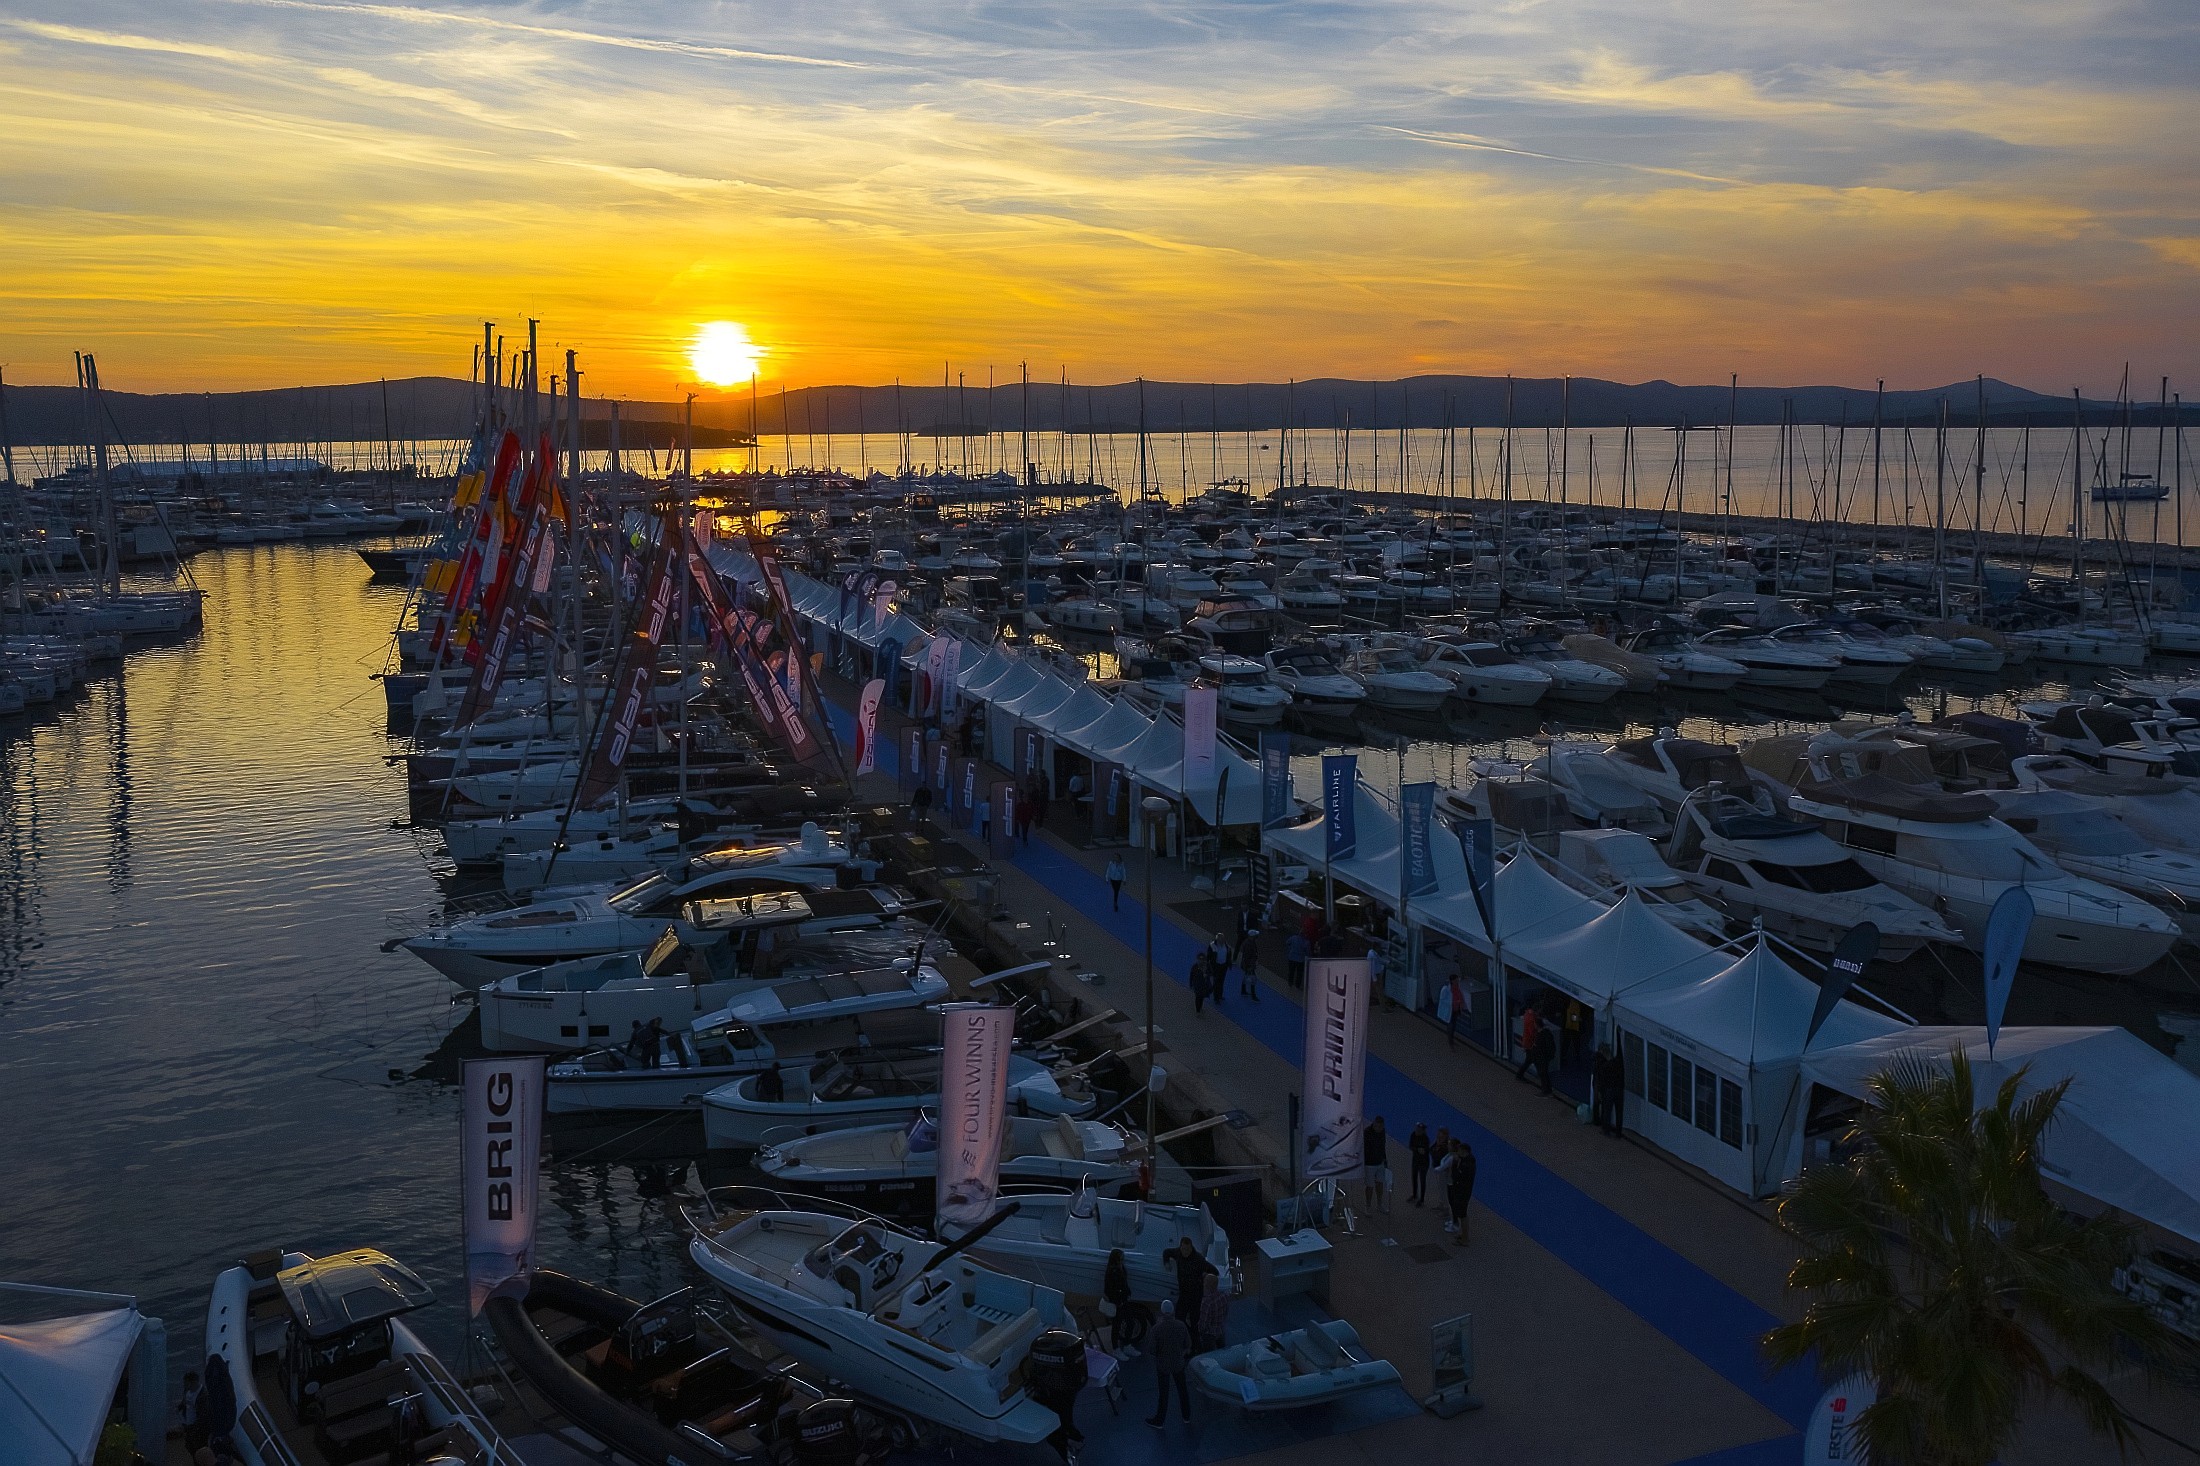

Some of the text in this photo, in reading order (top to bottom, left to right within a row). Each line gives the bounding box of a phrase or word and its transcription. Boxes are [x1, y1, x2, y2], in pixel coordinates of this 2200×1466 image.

[481, 606, 516, 692] elan
[609, 667, 648, 767] elan
[963, 762, 975, 809] elan
[1002, 786, 1013, 837] elan
[1332, 769, 1341, 829] FAIRLINE
[1322, 967, 1347, 1103] PRINCE
[962, 1016, 986, 1143] FOUR WINNS
[487, 1072, 514, 1221] BRIG
[801, 1420, 844, 1437] SUZUKI
[1829, 1415, 1844, 1459] ERSTE
